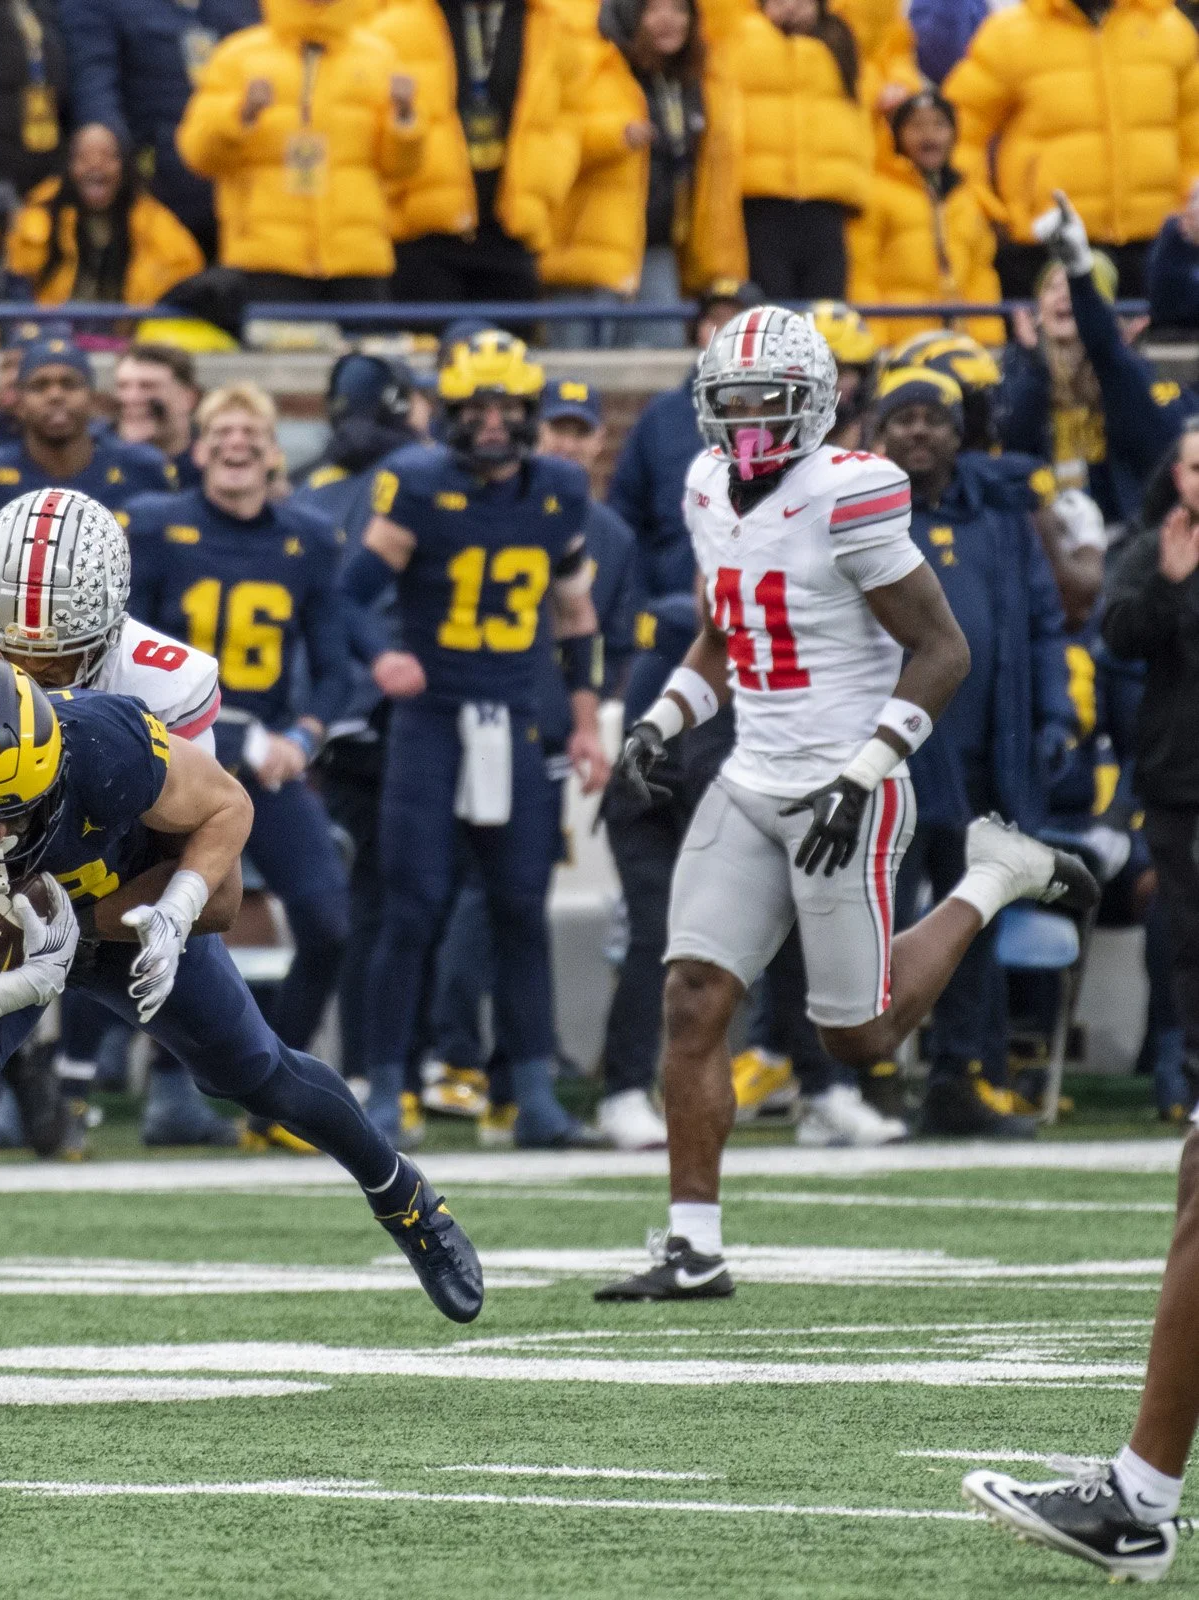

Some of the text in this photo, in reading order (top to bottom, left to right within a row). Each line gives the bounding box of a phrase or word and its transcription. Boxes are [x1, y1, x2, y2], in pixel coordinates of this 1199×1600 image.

[180, 576, 294, 692] 16
[436, 545, 551, 654] 13
[713, 567, 811, 692] 41
[133, 640, 190, 672] 6
